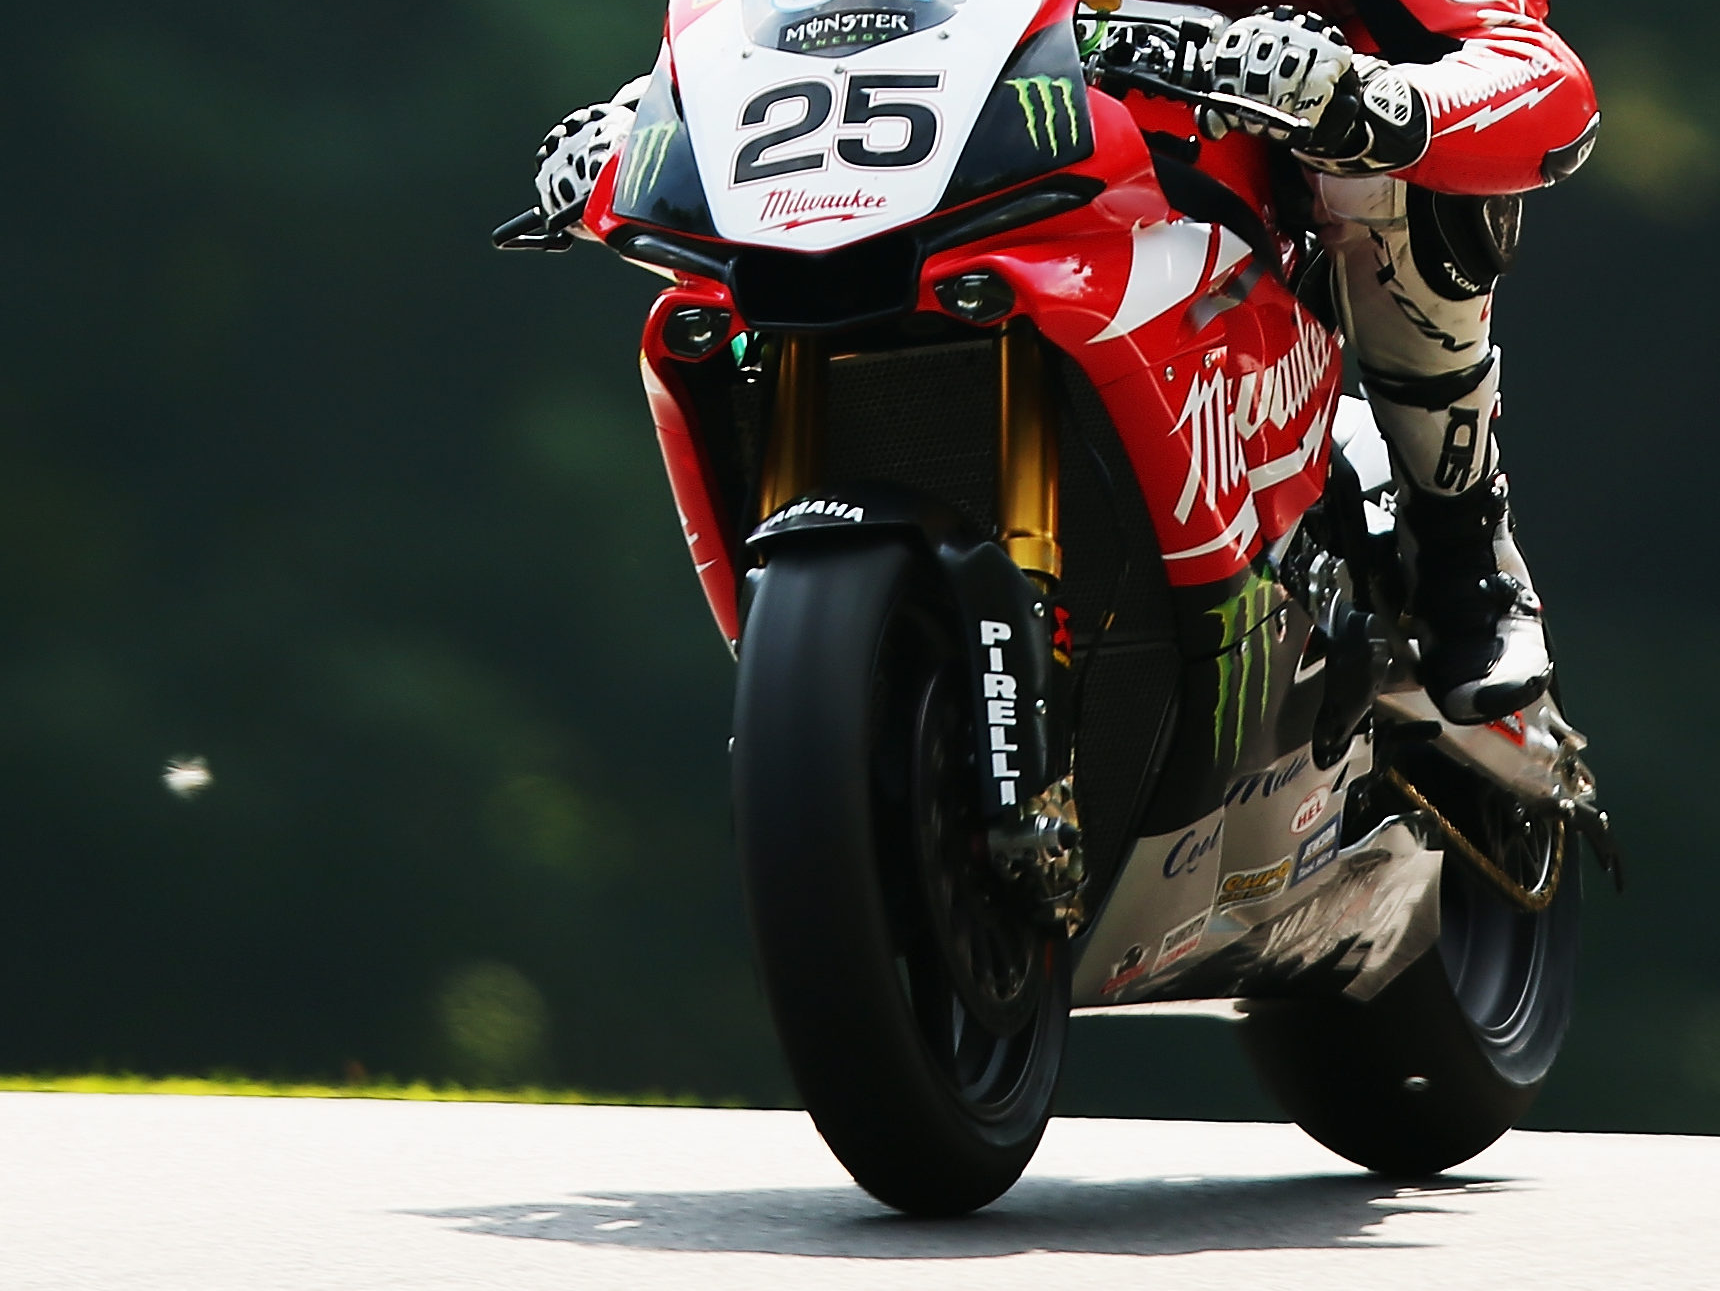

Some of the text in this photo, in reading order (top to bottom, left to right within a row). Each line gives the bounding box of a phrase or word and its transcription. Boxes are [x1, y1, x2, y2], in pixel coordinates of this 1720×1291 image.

[785, 11, 910, 42] MONSTER
[801, 32, 890, 51] ENERGY
[731, 72, 943, 186] 25
[757, 187, 887, 222] Milwaukee
[980, 619, 1021, 807] PIRELLI
[1297, 799, 1323, 830] HEL
